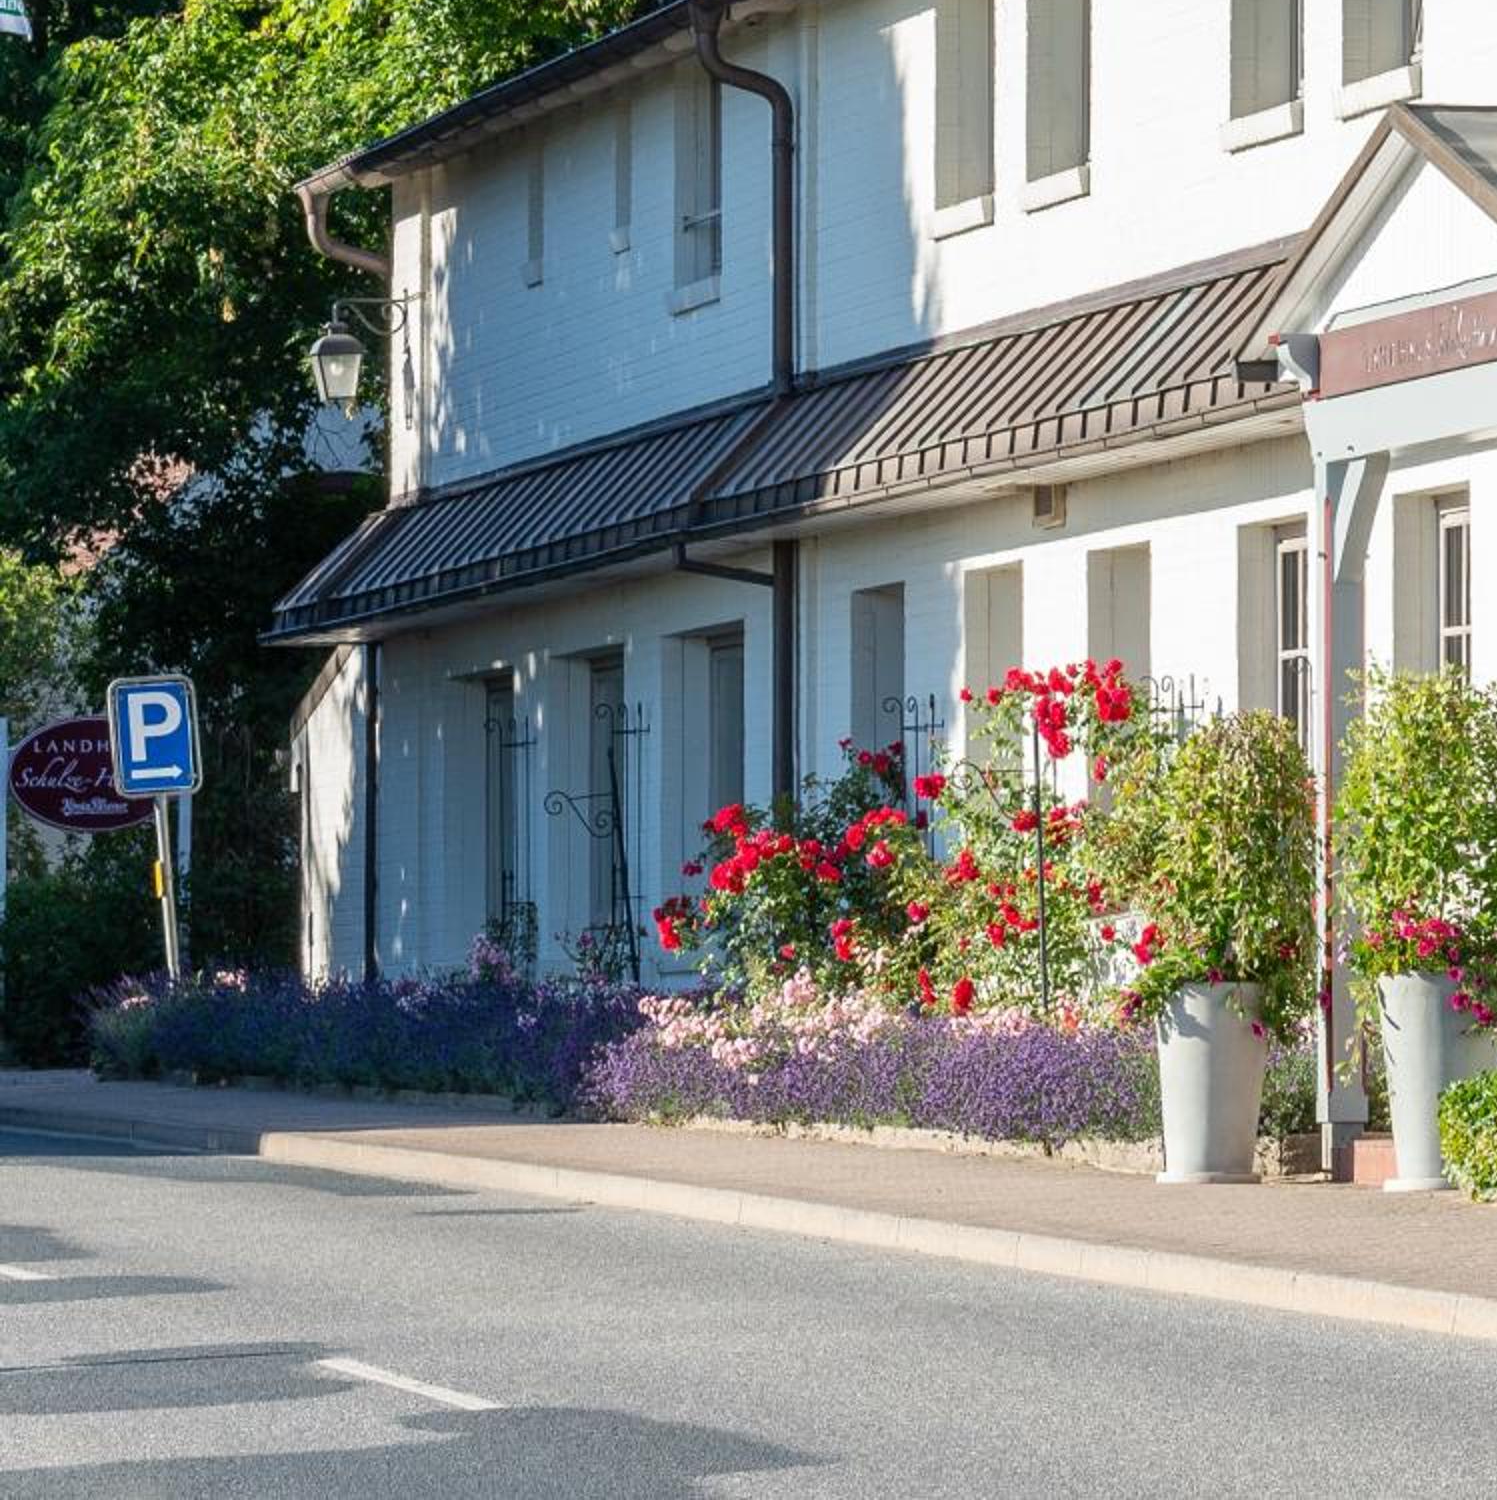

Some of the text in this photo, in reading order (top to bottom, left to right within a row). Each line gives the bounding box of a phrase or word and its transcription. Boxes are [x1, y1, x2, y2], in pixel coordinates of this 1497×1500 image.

[128, 692, 181, 761] P
[33, 739, 109, 753] LANDH
[15, 756, 114, 793] Schulze-H
